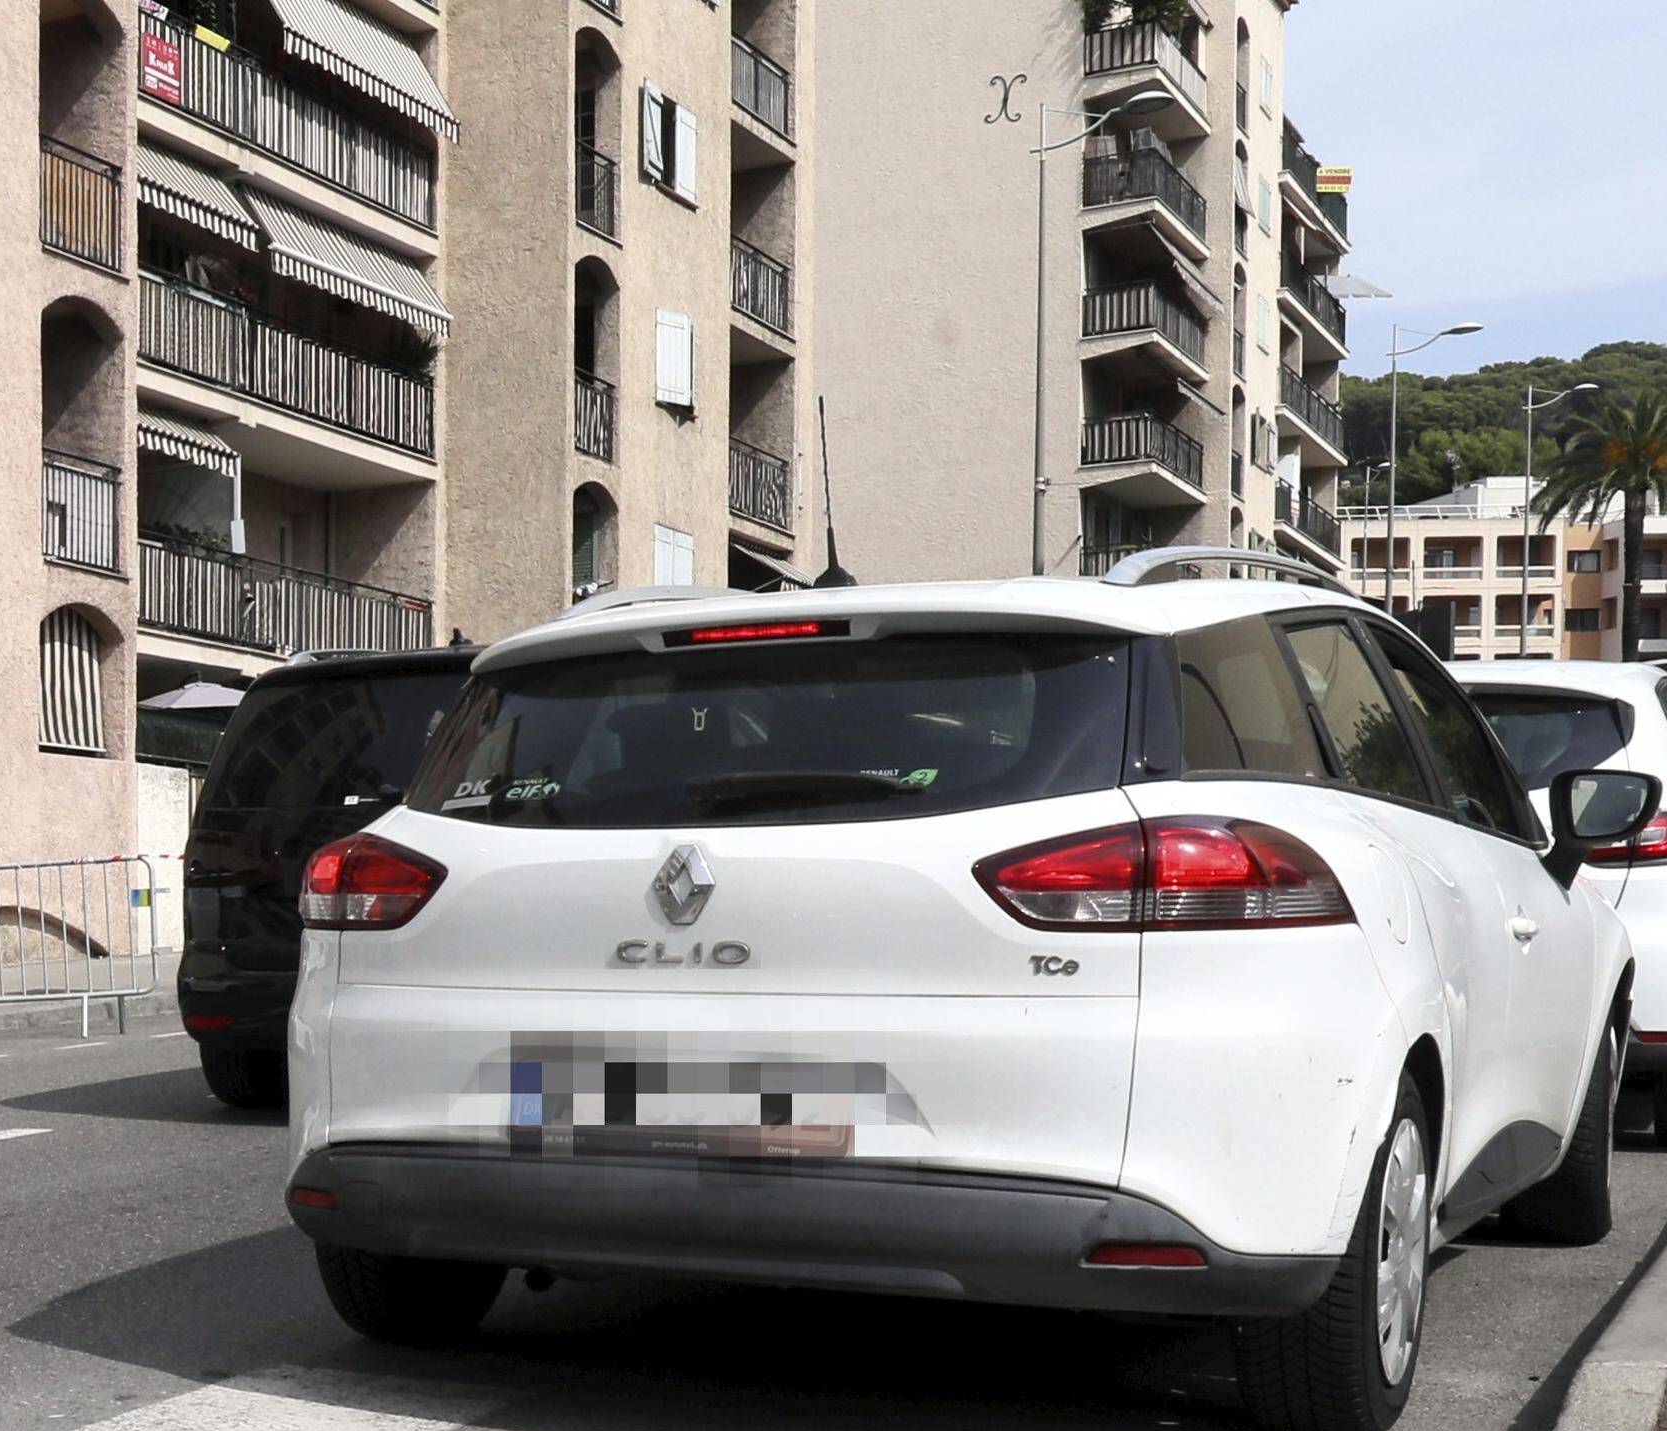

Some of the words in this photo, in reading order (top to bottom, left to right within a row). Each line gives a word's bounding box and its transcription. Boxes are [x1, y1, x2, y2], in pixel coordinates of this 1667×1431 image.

[453, 779, 492, 798] DK
[616, 938, 752, 965] CLIO
[1028, 955, 1080, 977] TCe
[767, 1144, 801, 1156] Otterup
